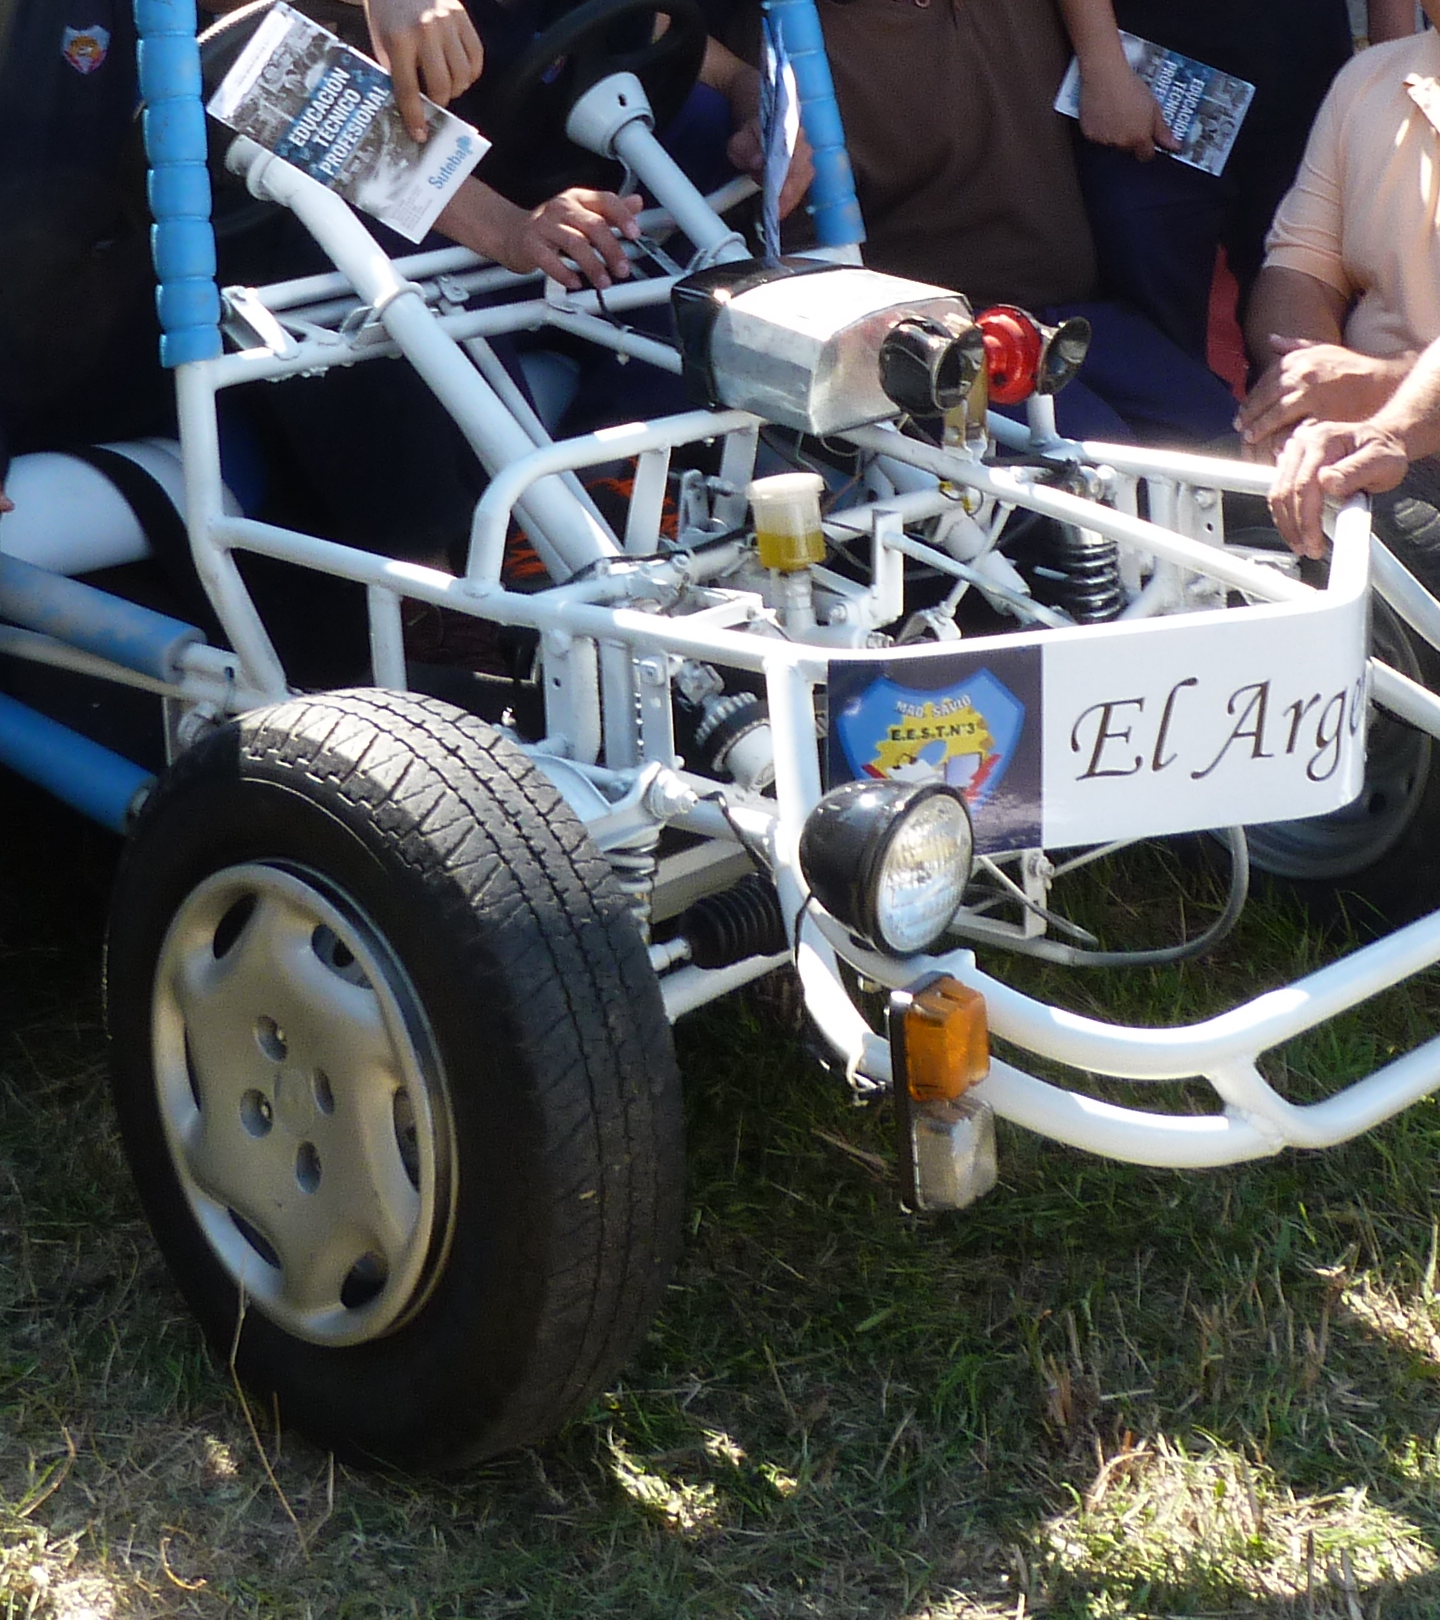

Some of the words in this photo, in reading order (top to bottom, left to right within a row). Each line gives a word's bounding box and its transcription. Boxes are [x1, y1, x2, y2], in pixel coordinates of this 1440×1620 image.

[318, 86, 389, 176] PROFESIONAL
[931, 693, 973, 718] SAVIO
[1071, 677, 1198, 781] El
